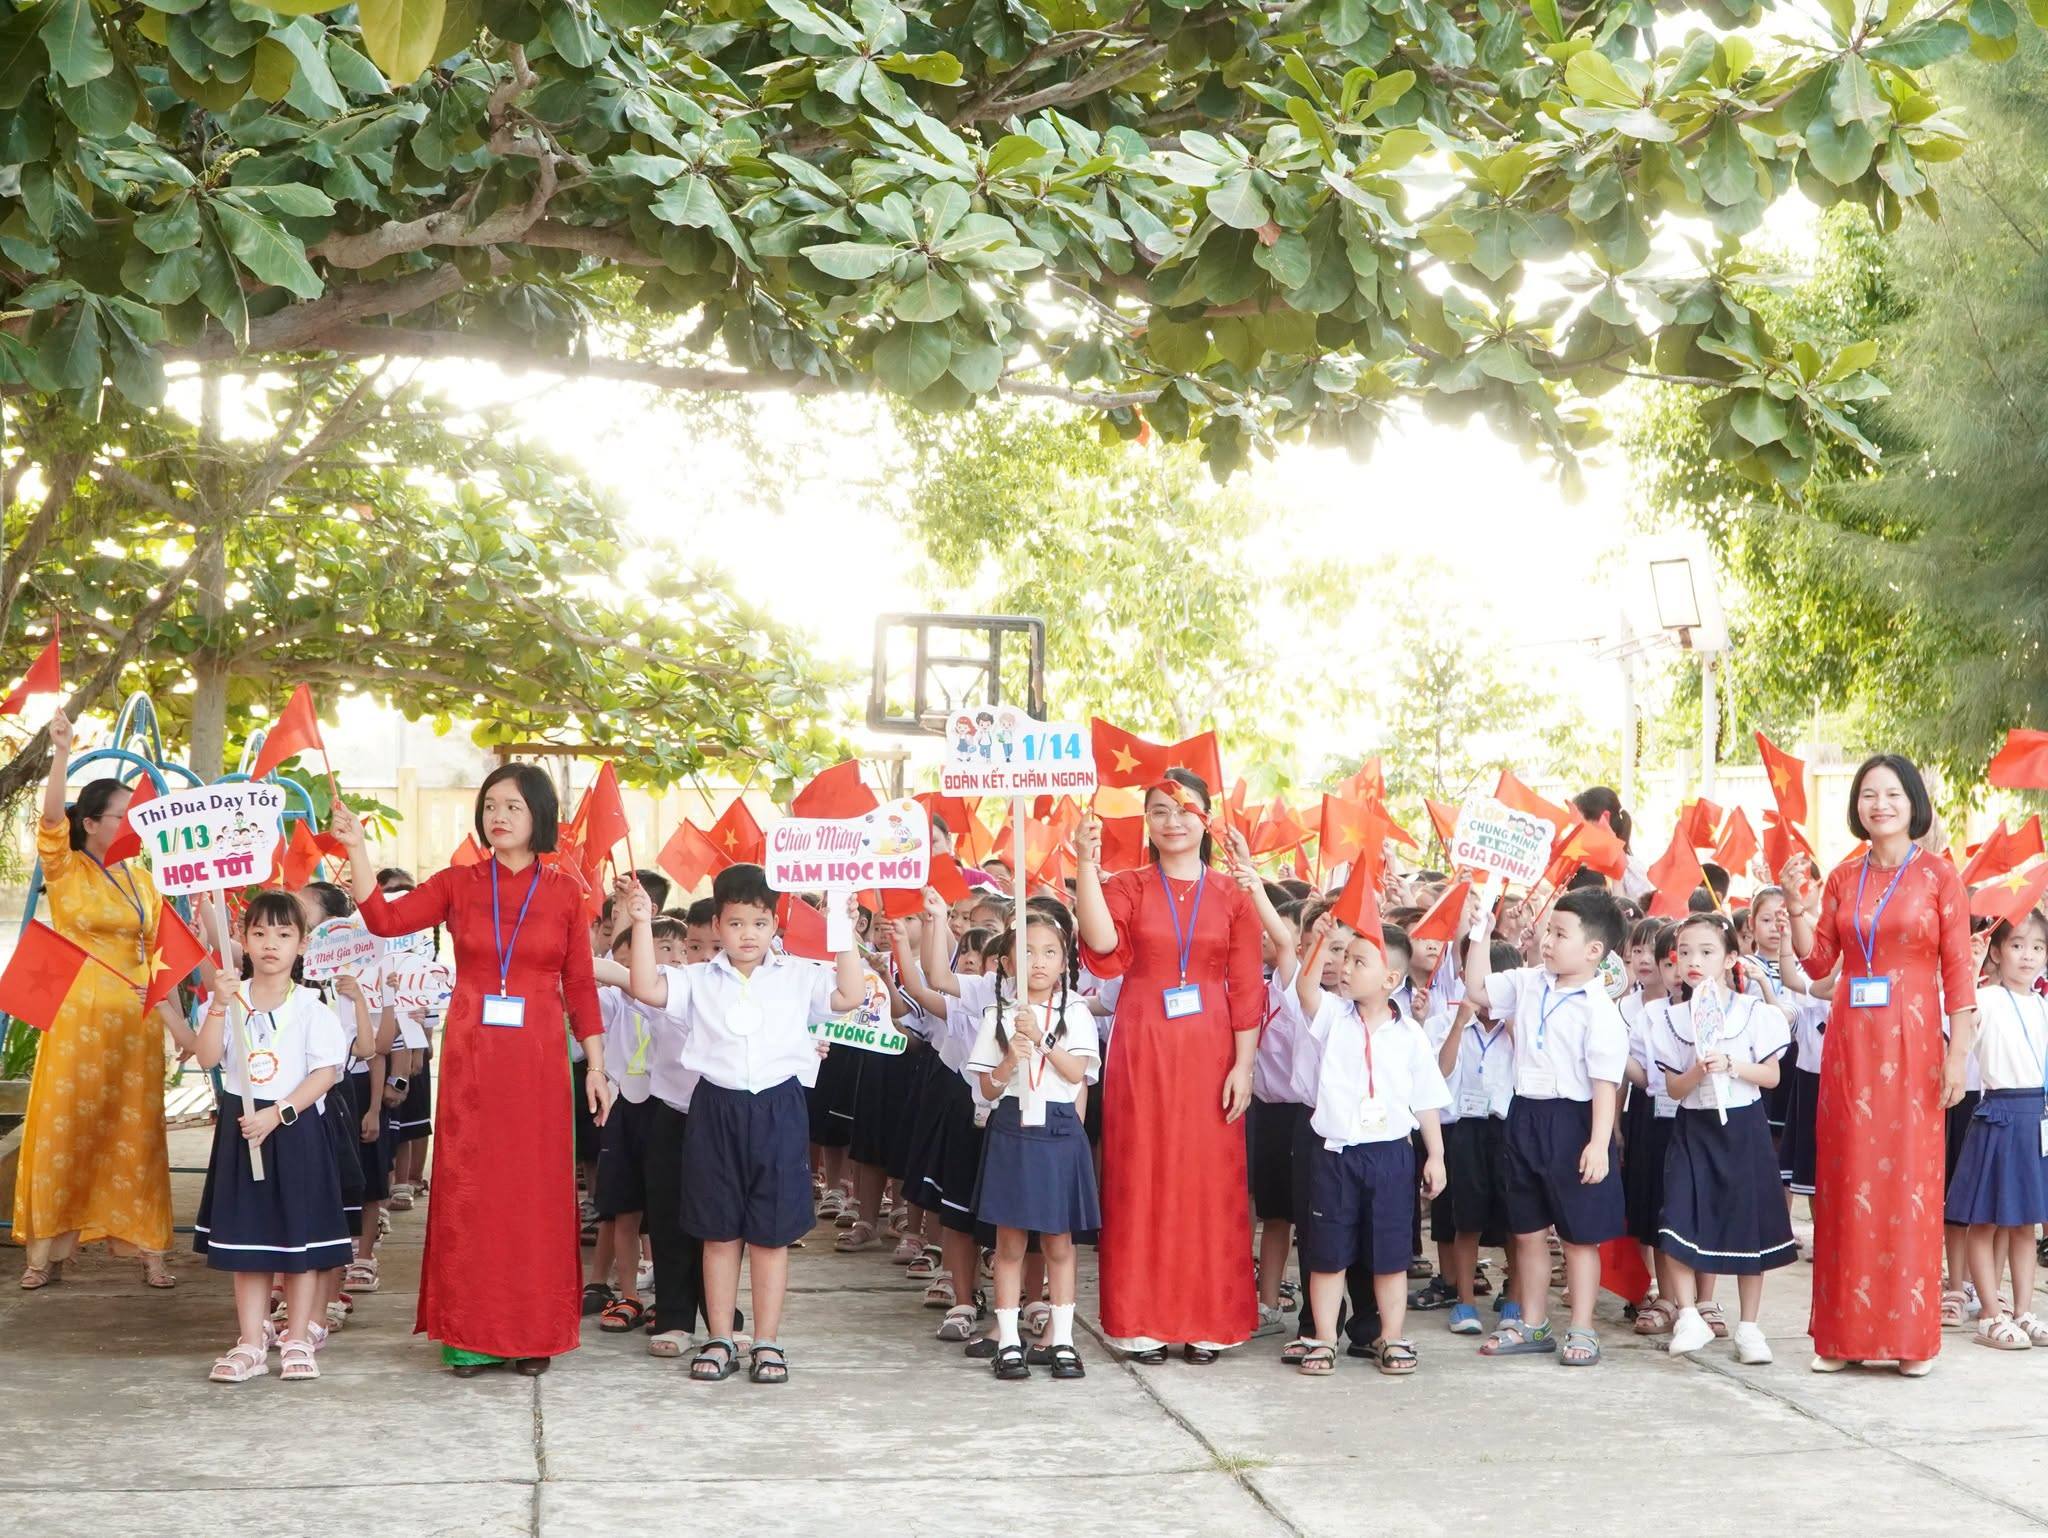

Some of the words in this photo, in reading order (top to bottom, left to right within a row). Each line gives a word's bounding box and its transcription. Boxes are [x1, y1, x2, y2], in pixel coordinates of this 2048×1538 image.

[1022, 733, 1081, 761] 1/14
[944, 770, 979, 790] ĐOÀN
[1012, 769, 1048, 789] CHĂM
[1051, 771, 1095, 788] NGOAN
[138, 805, 167, 827] Thi
[170, 800, 206, 817] Đua
[209, 794, 243, 811] Dạy
[248, 789, 278, 808] Tốt
[156, 824, 212, 854] 1/13
[774, 827, 811, 852] Chào
[816, 822, 863, 857] Mừng
[1457, 842, 1487, 863] GIA
[163, 861, 210, 889] HỌC
[213, 851, 254, 879] TỐT
[776, 860, 823, 883] NĂM
[827, 861, 875, 885] HỌC
[879, 856, 921, 880] MỚI
[336, 946, 351, 962] Gia
[824, 1022, 876, 1045] TƯƠNG
[879, 1033, 906, 1051] LAI
